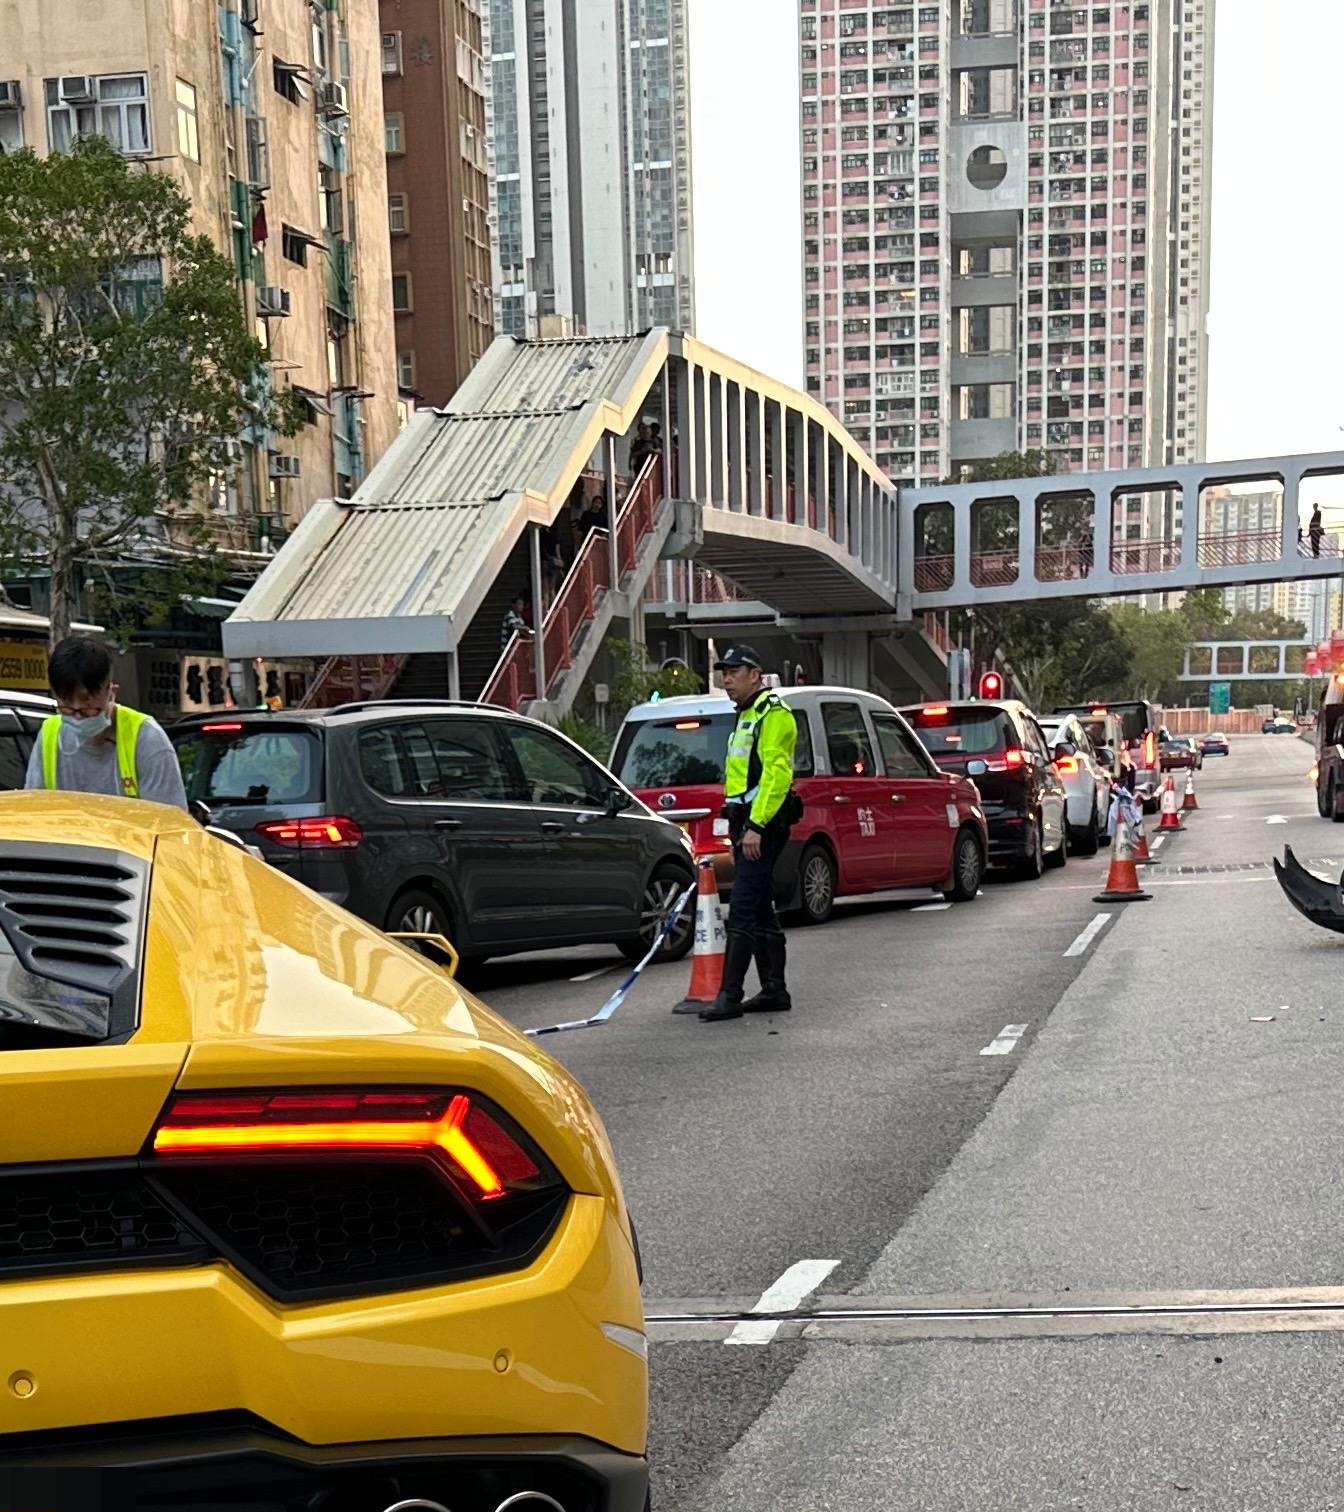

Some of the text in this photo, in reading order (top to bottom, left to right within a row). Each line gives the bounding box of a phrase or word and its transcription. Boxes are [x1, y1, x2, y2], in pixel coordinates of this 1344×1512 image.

[24, 658, 46, 681] 0000
[857, 807, 872, 821] 的士
[859, 822, 875, 836] TAXI
